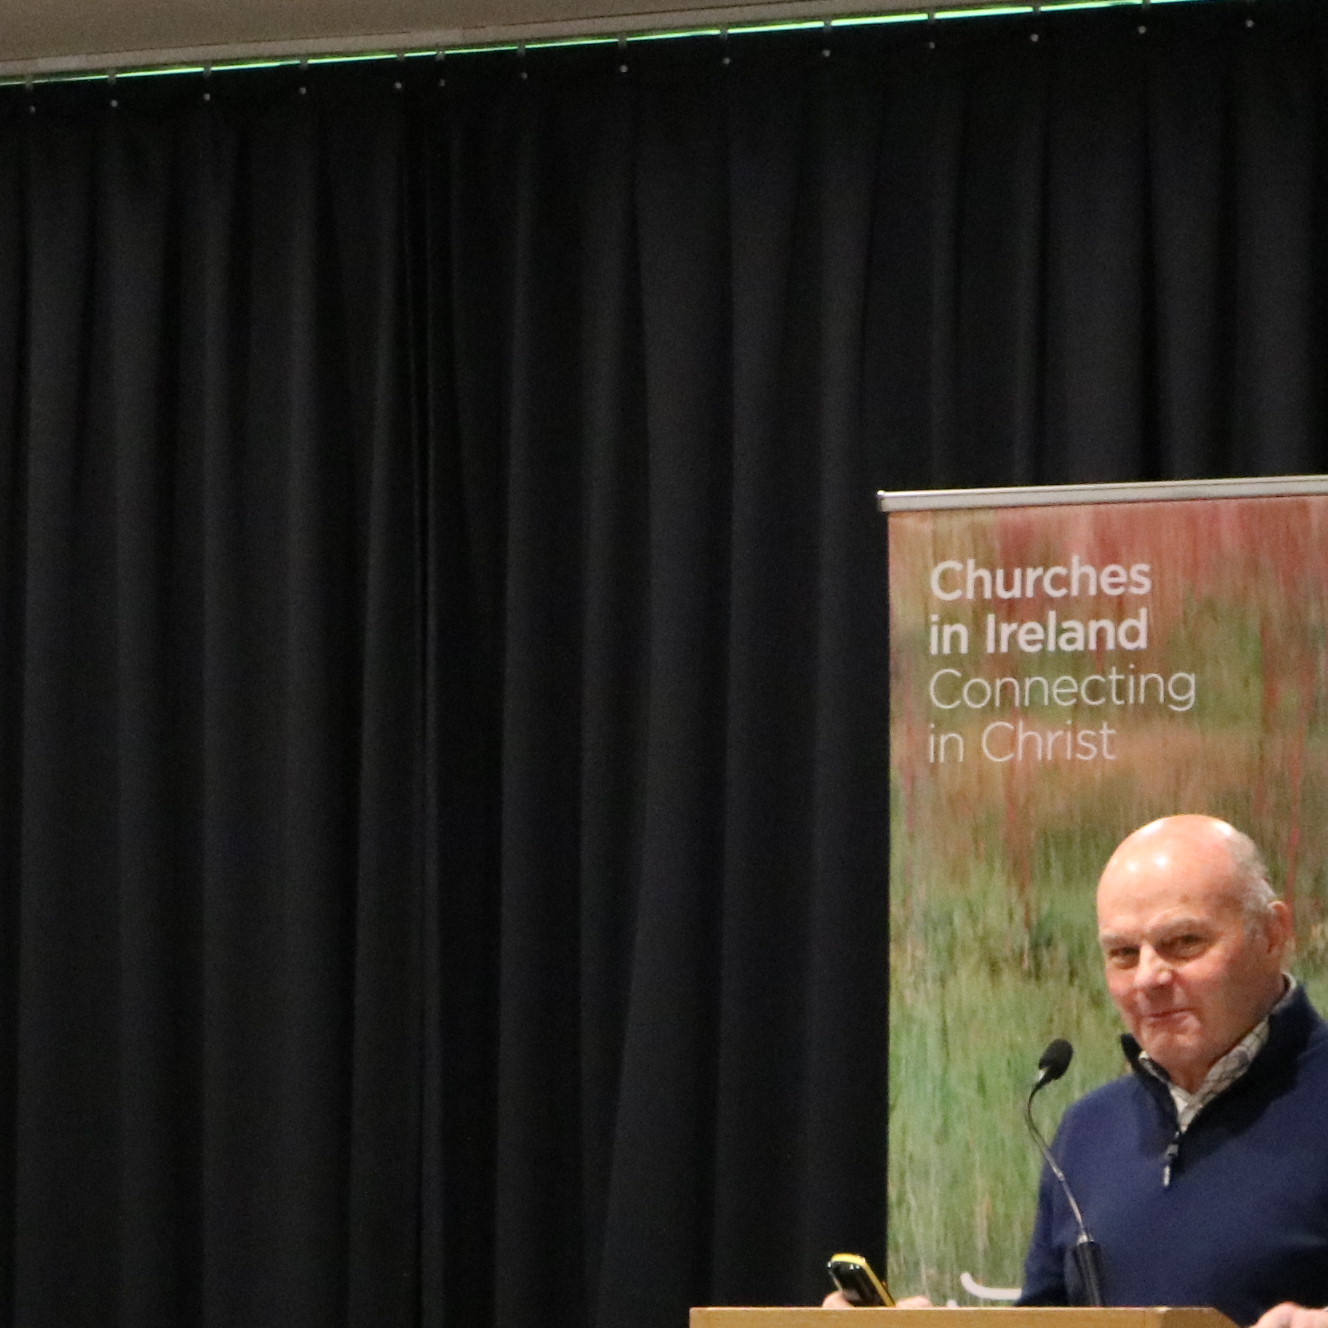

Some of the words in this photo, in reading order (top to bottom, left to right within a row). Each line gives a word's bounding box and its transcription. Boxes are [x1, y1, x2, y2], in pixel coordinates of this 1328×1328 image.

[929, 555, 1152, 601] Churches
[929, 613, 969, 655] in
[986, 607, 1148, 654] Ireland
[929, 663, 1197, 712] Connecting
[929, 722, 965, 763] in
[981, 719, 1117, 763] Christ
